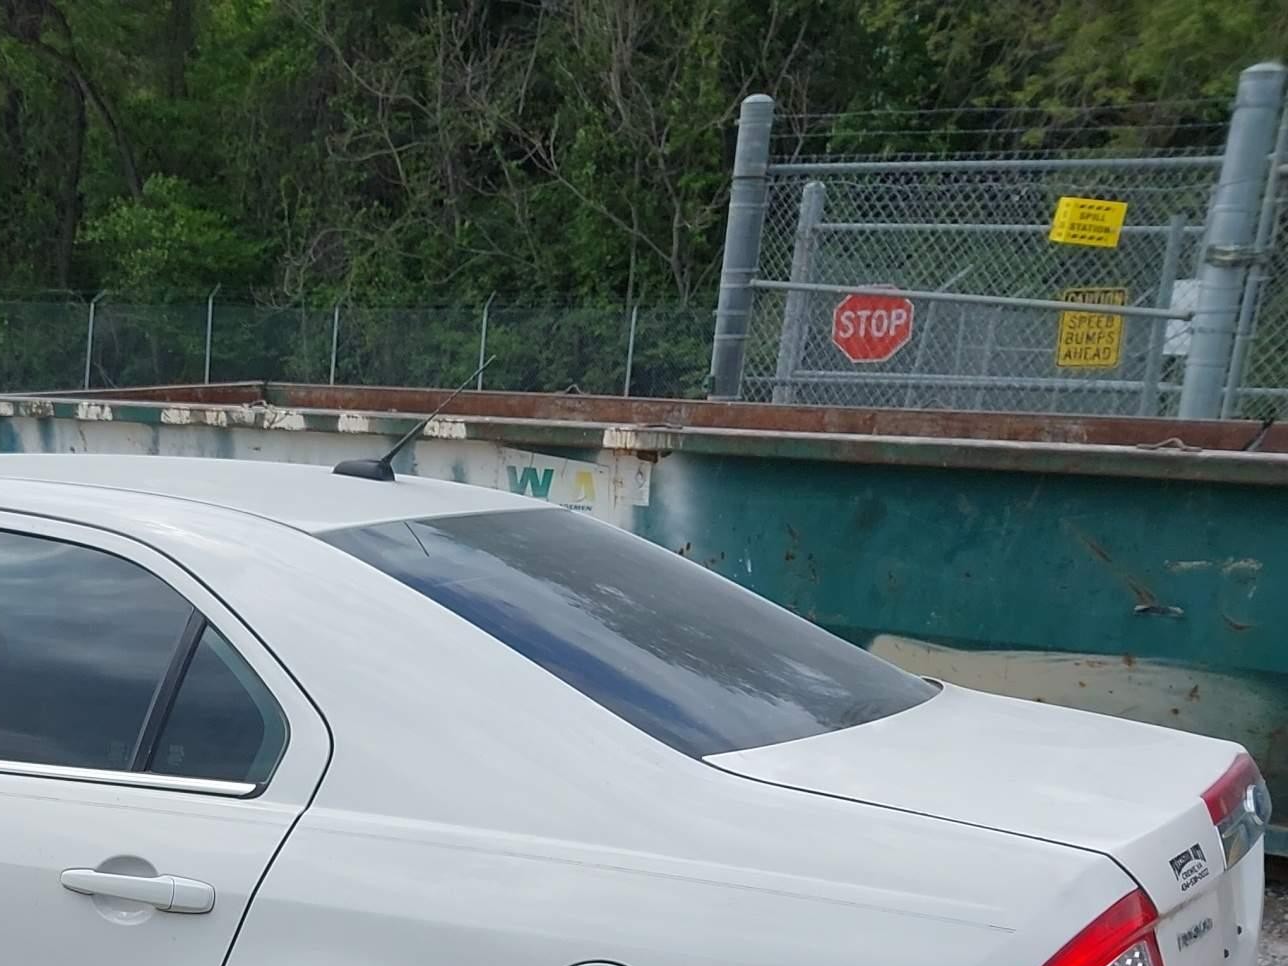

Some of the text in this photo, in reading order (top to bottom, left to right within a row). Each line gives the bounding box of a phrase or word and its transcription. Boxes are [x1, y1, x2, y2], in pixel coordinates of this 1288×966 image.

[839, 309, 907, 338] STOP
[1068, 314, 1114, 329] SPEED
[1064, 331, 1115, 345] BUMPS
[1063, 346, 1112, 361] AHEAD
